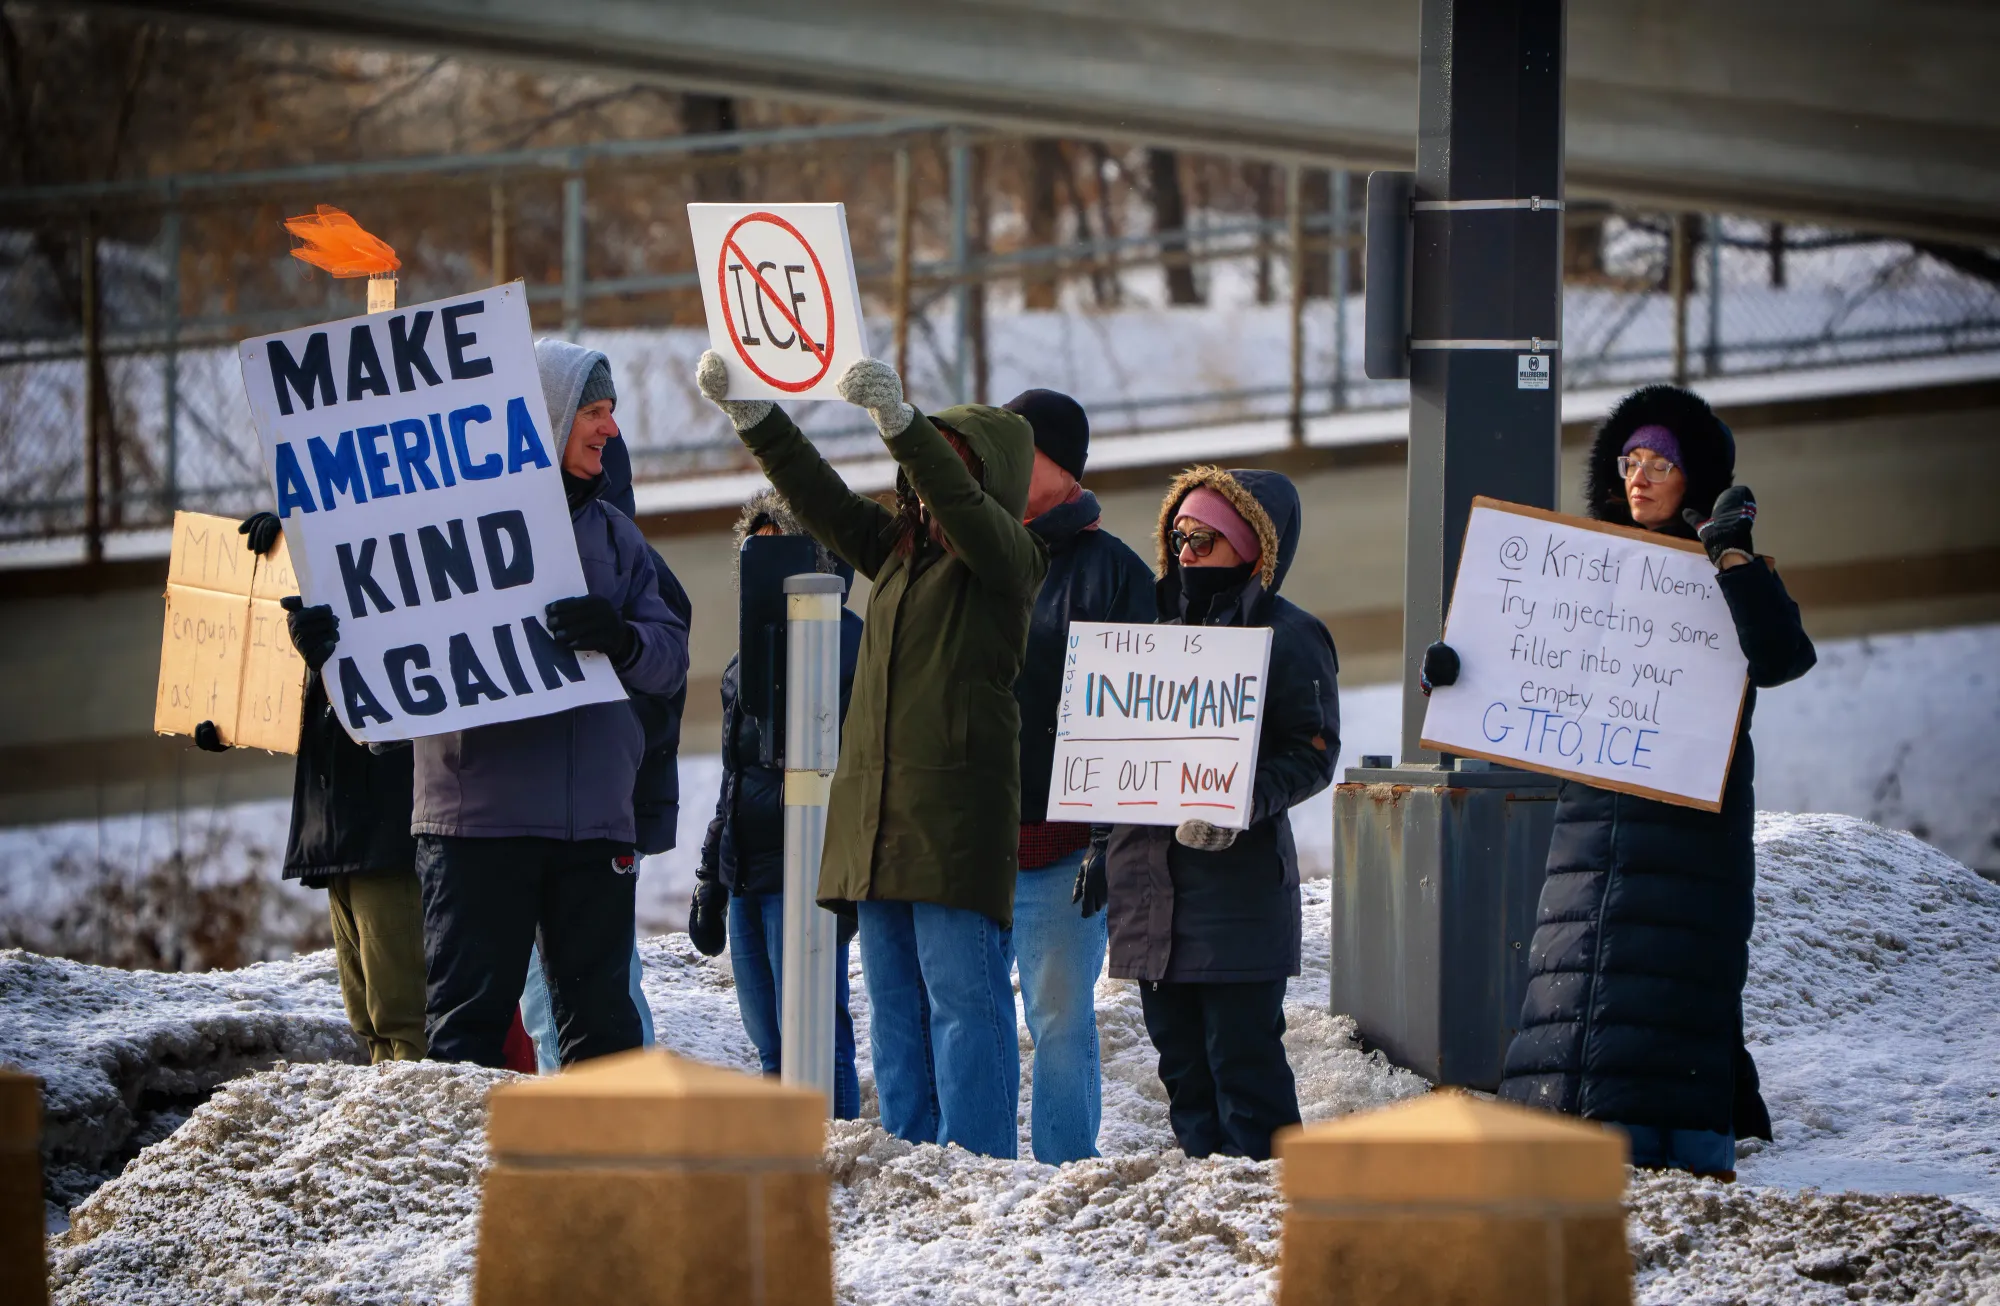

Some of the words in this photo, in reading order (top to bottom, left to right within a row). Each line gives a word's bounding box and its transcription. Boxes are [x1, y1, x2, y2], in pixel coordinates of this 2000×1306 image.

[728, 261, 825, 353] ICE
[266, 300, 494, 416] MAKE
[275, 396, 552, 519] AMERICA
[180, 524, 242, 582] MN
[263, 561, 299, 590] ha
[335, 509, 534, 619] KIND
[1499, 536, 1529, 571] @
[1541, 533, 1621, 585] Kristi
[1639, 555, 1714, 601] Noem:
[172, 612, 237, 659] enough
[1096, 630, 1156, 655] THIS
[1183, 634, 1203, 654] IS
[1497, 577, 1537, 629] Try
[1552, 598, 1654, 648] injecting
[1668, 620, 1720, 650] some
[338, 615, 586, 729] AGAIN
[1060, 635, 1080, 724] UNJUST
[1510, 634, 1572, 668] filler
[1580, 646, 1621, 675] into
[1630, 663, 1684, 688] your
[170, 682, 191, 709] as
[205, 681, 218, 716] it
[252, 680, 285, 724] is!
[1085, 671, 1258, 729] INHUMANE
[1520, 679, 1594, 724] empty
[1607, 690, 1661, 726] soul
[1482, 702, 1584, 766] GTFO,
[1594, 722, 1660, 770] ICE
[1063, 756, 1104, 796] ICE
[1118, 759, 1172, 792] OUT
[1180, 762, 1239, 795] NOW
